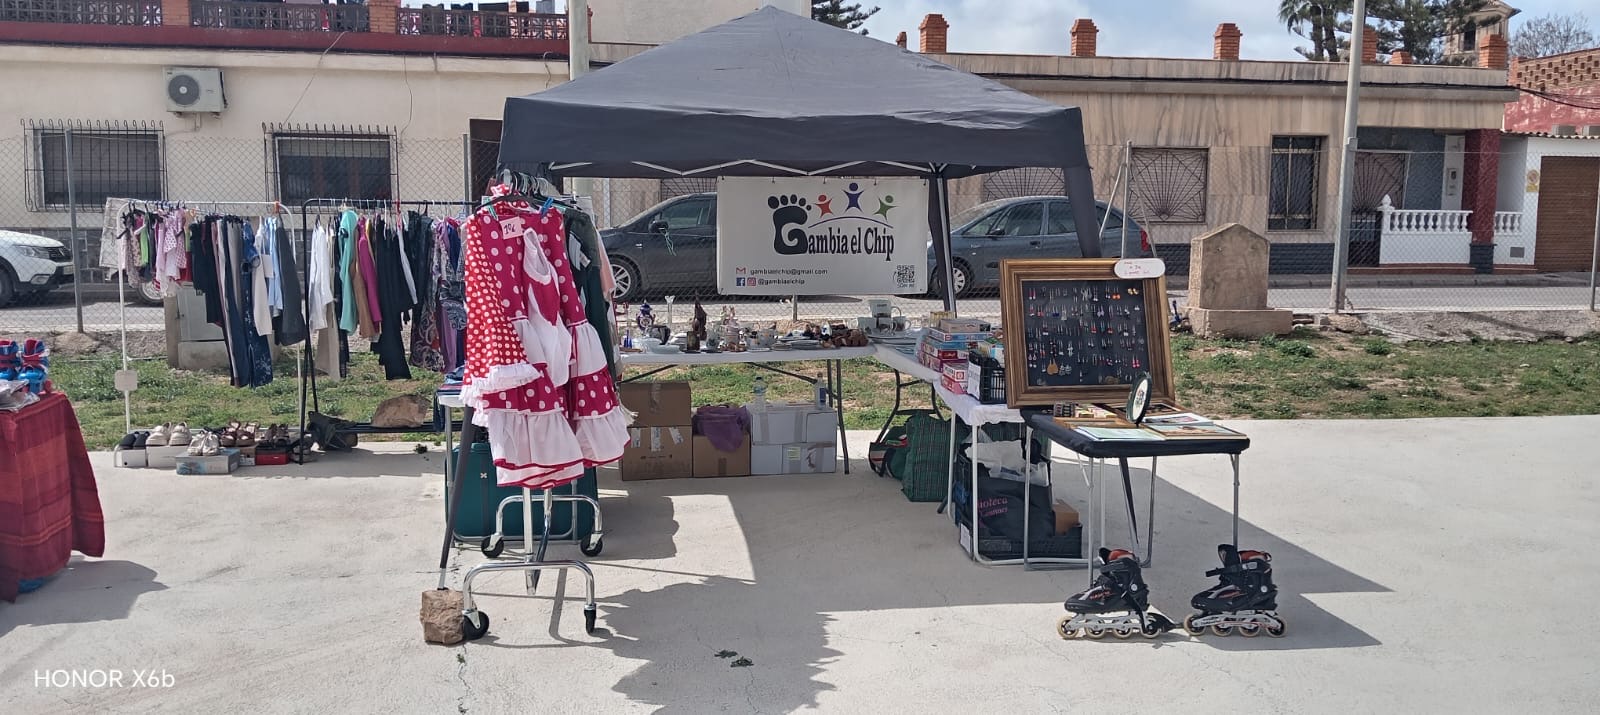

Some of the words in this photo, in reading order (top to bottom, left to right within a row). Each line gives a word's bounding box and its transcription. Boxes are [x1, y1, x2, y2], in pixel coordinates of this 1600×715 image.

[773, 205, 848, 255] Gambia
[851, 226, 862, 254] el
[864, 226, 895, 261] Chip
